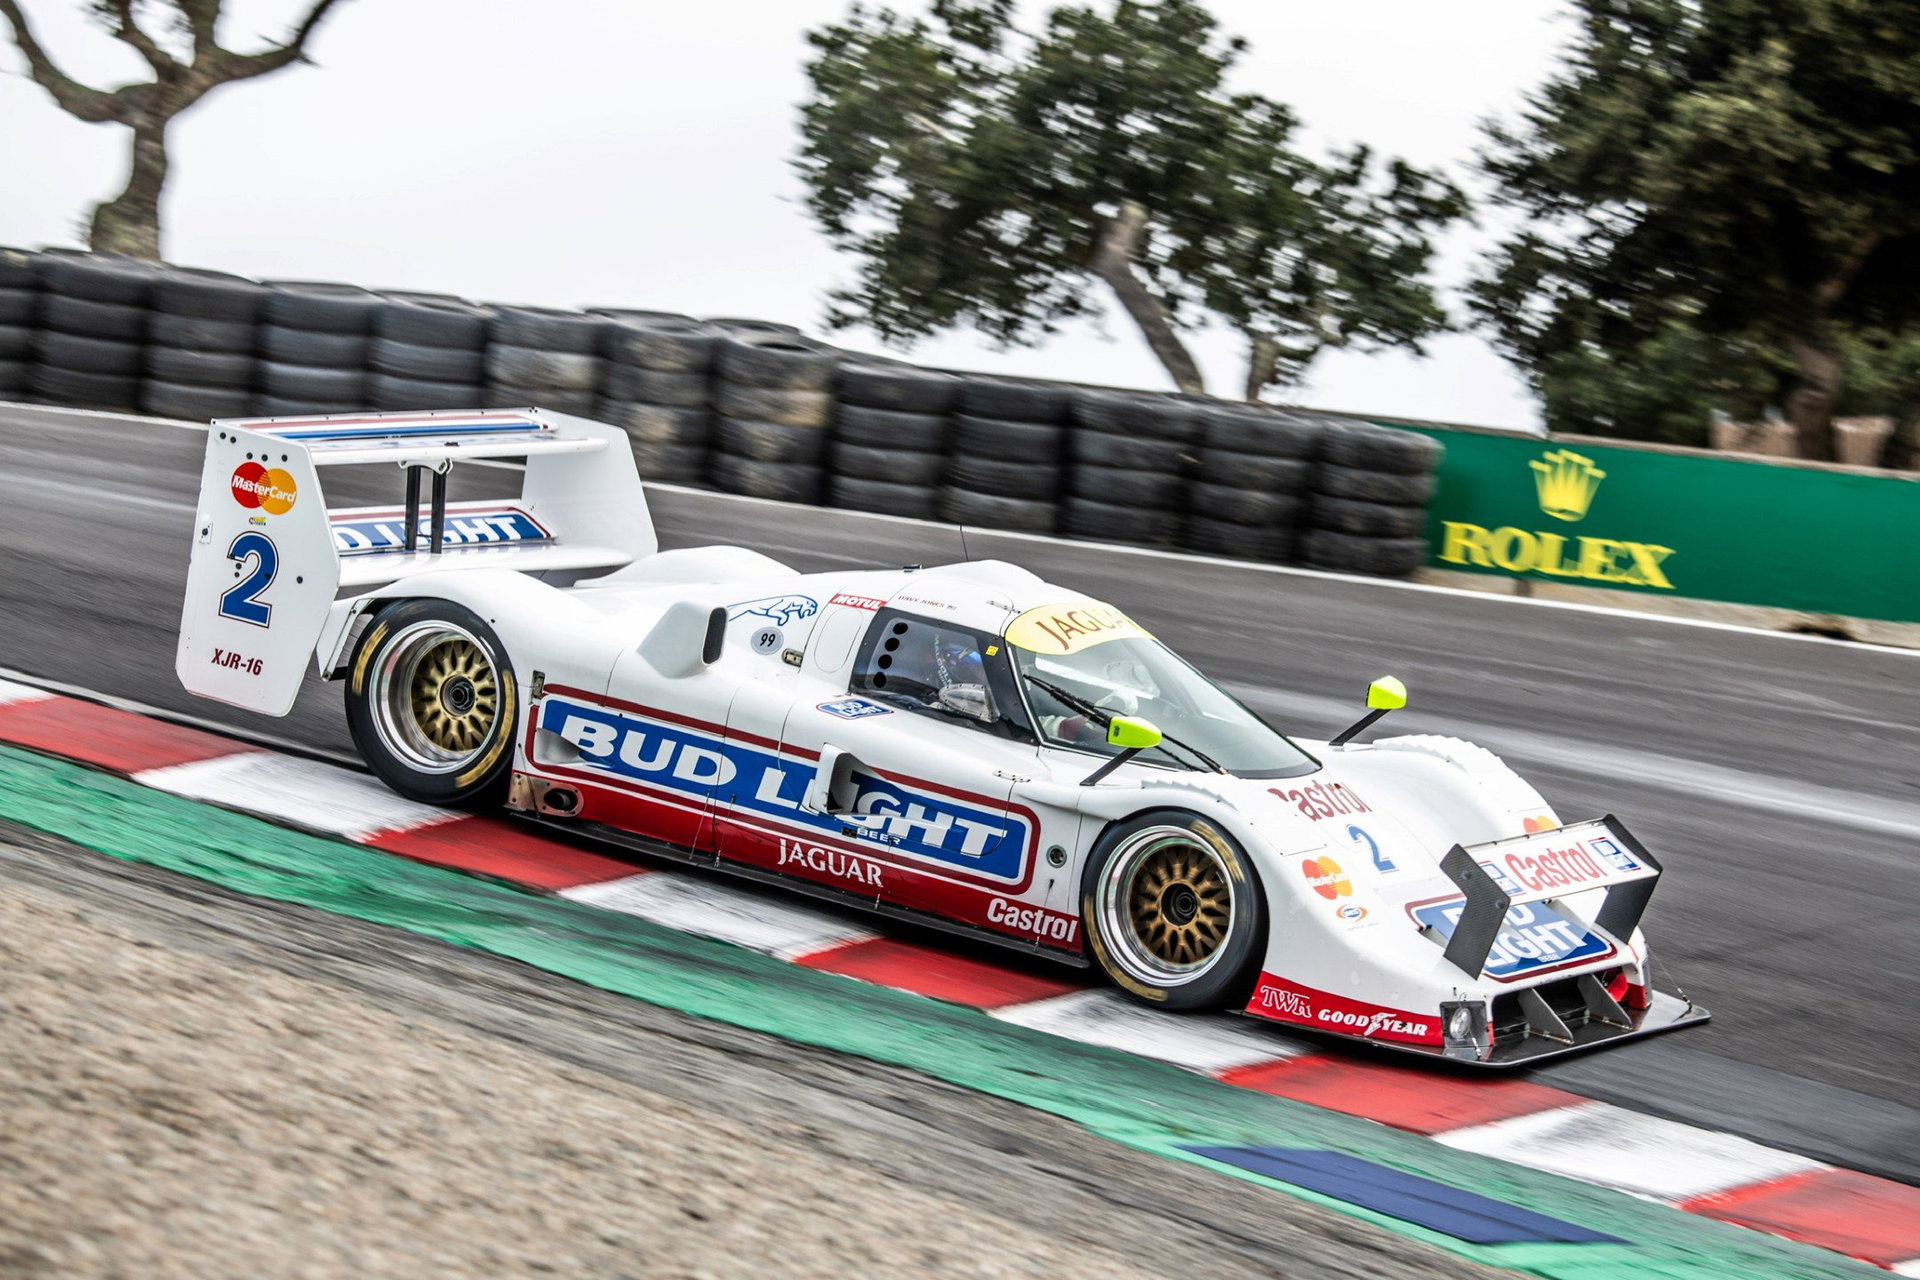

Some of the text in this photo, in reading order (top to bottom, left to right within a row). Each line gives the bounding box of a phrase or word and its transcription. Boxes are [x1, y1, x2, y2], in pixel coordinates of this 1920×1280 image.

[231, 474, 297, 503] MasterCard
[1436, 520, 1677, 590] ROLEX
[219, 530, 280, 629] 2
[831, 594, 883, 610] MOTUL
[211, 648, 264, 676] XJR-16
[759, 632, 776, 647] 99
[560, 714, 737, 786] BUD
[857, 827, 901, 845] BEER
[1346, 823, 1400, 874] 2
[777, 838, 884, 888] JAGUAR
[1504, 842, 1608, 891] Castrol
[987, 897, 1078, 943] Castrol
